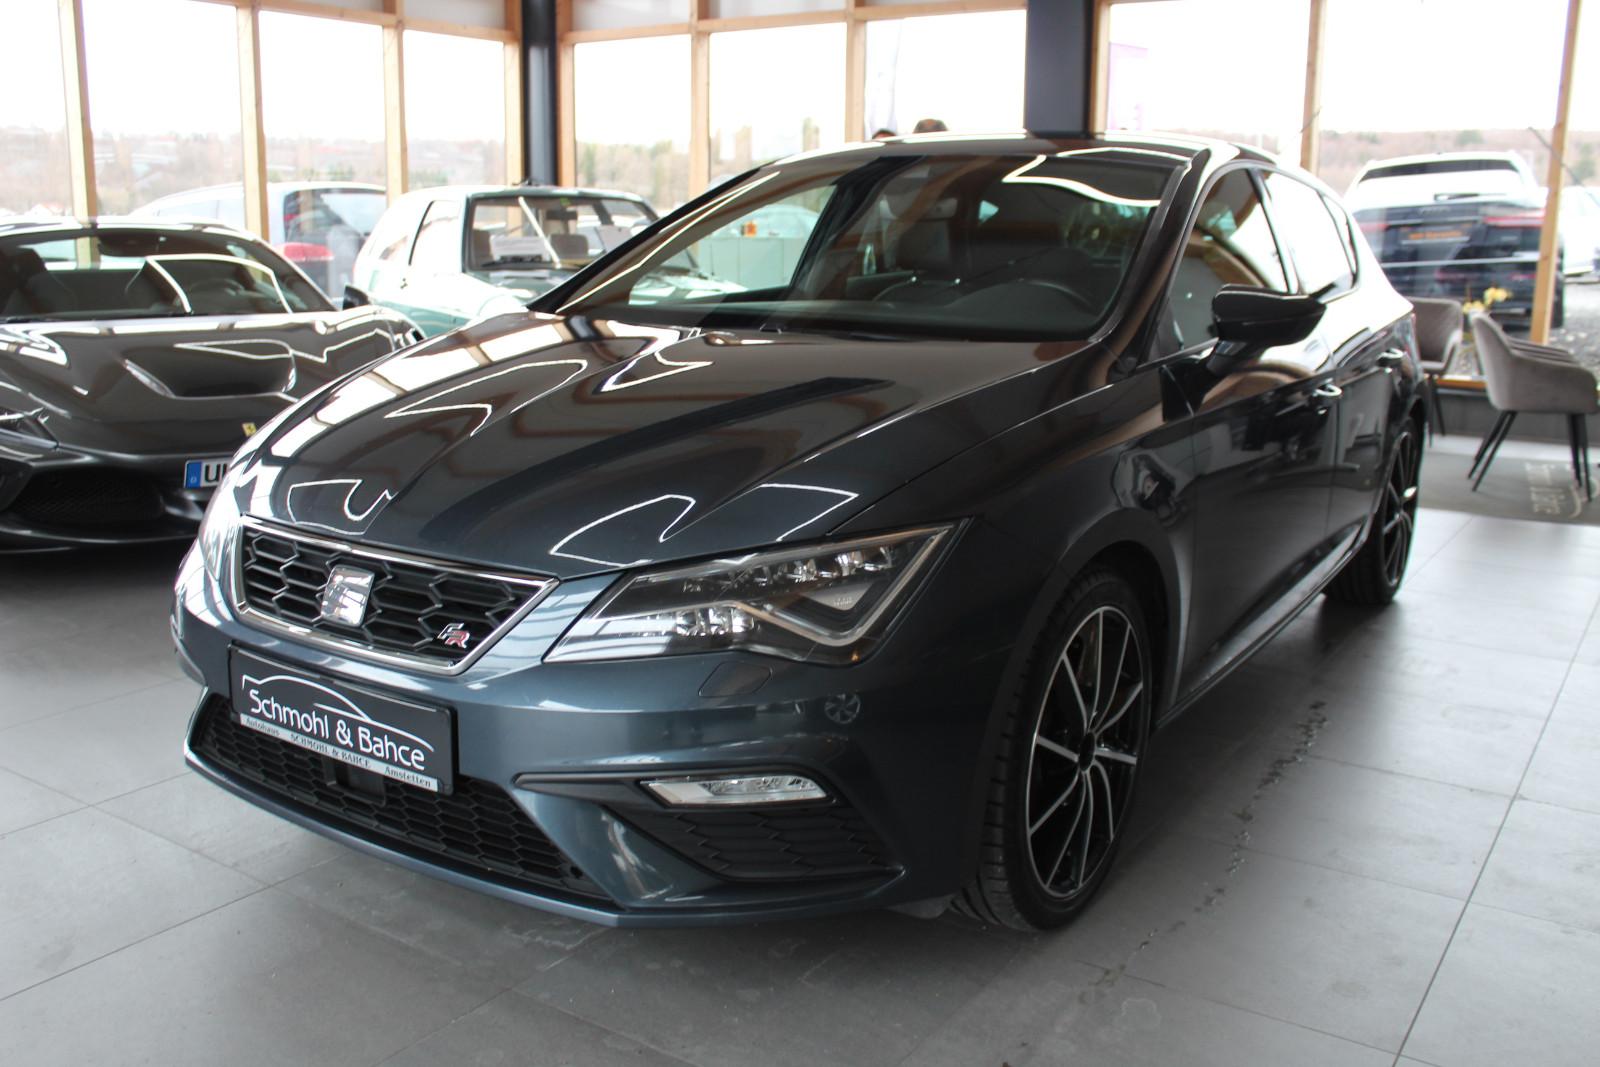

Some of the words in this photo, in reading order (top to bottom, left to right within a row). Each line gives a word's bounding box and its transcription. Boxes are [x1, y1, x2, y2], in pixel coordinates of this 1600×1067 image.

[437, 623, 470, 648] FR
[245, 717, 280, 737] Autohaus
[290, 733, 330, 754] SCHMOHL
[342, 752, 371, 768] BAHCE
[384, 766, 431, 788] Amstetten
[250, 689, 329, 739] Schmohl
[335, 720, 353, 749] &
[358, 727, 425, 771] Bahce
